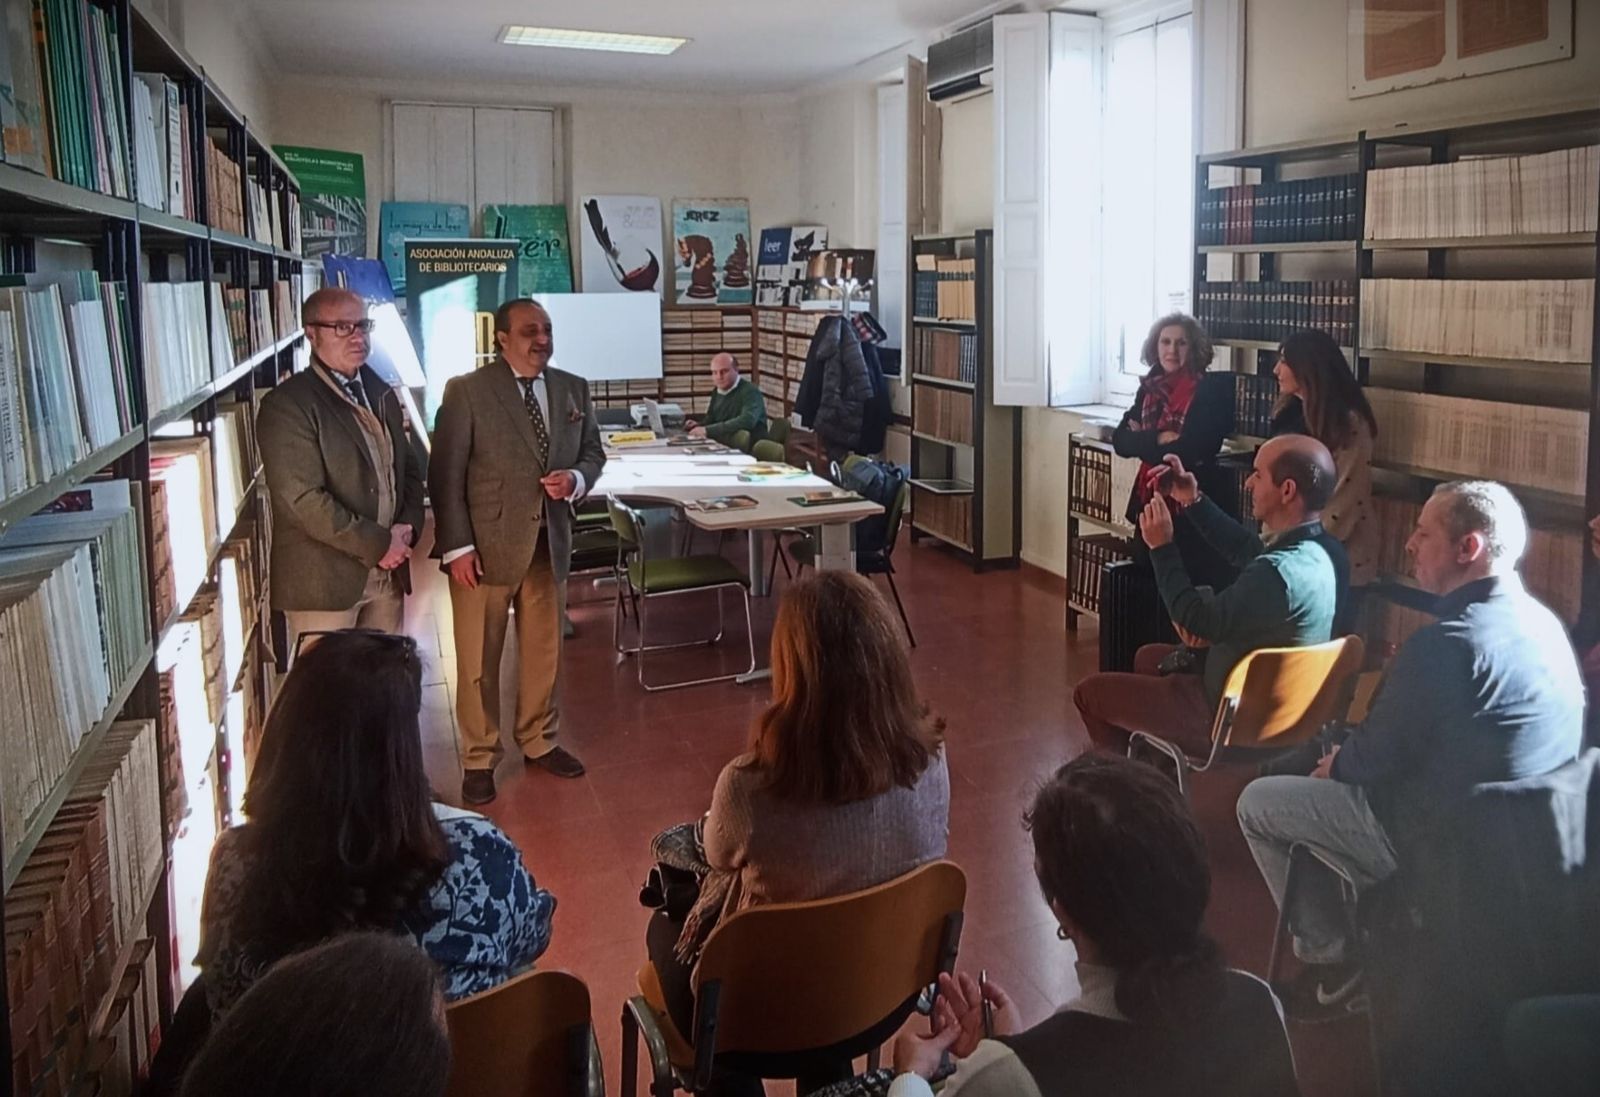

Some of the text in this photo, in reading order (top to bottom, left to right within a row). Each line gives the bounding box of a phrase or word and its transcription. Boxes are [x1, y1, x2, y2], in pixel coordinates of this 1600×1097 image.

[683, 210, 720, 222] JEREZ
[495, 215, 561, 258] ler
[764, 237, 782, 253] leer
[410, 247, 515, 259] ASOCIACIÓN ANDALUZA
[419, 262, 507, 273] DE BIBLIOTECARIOS
